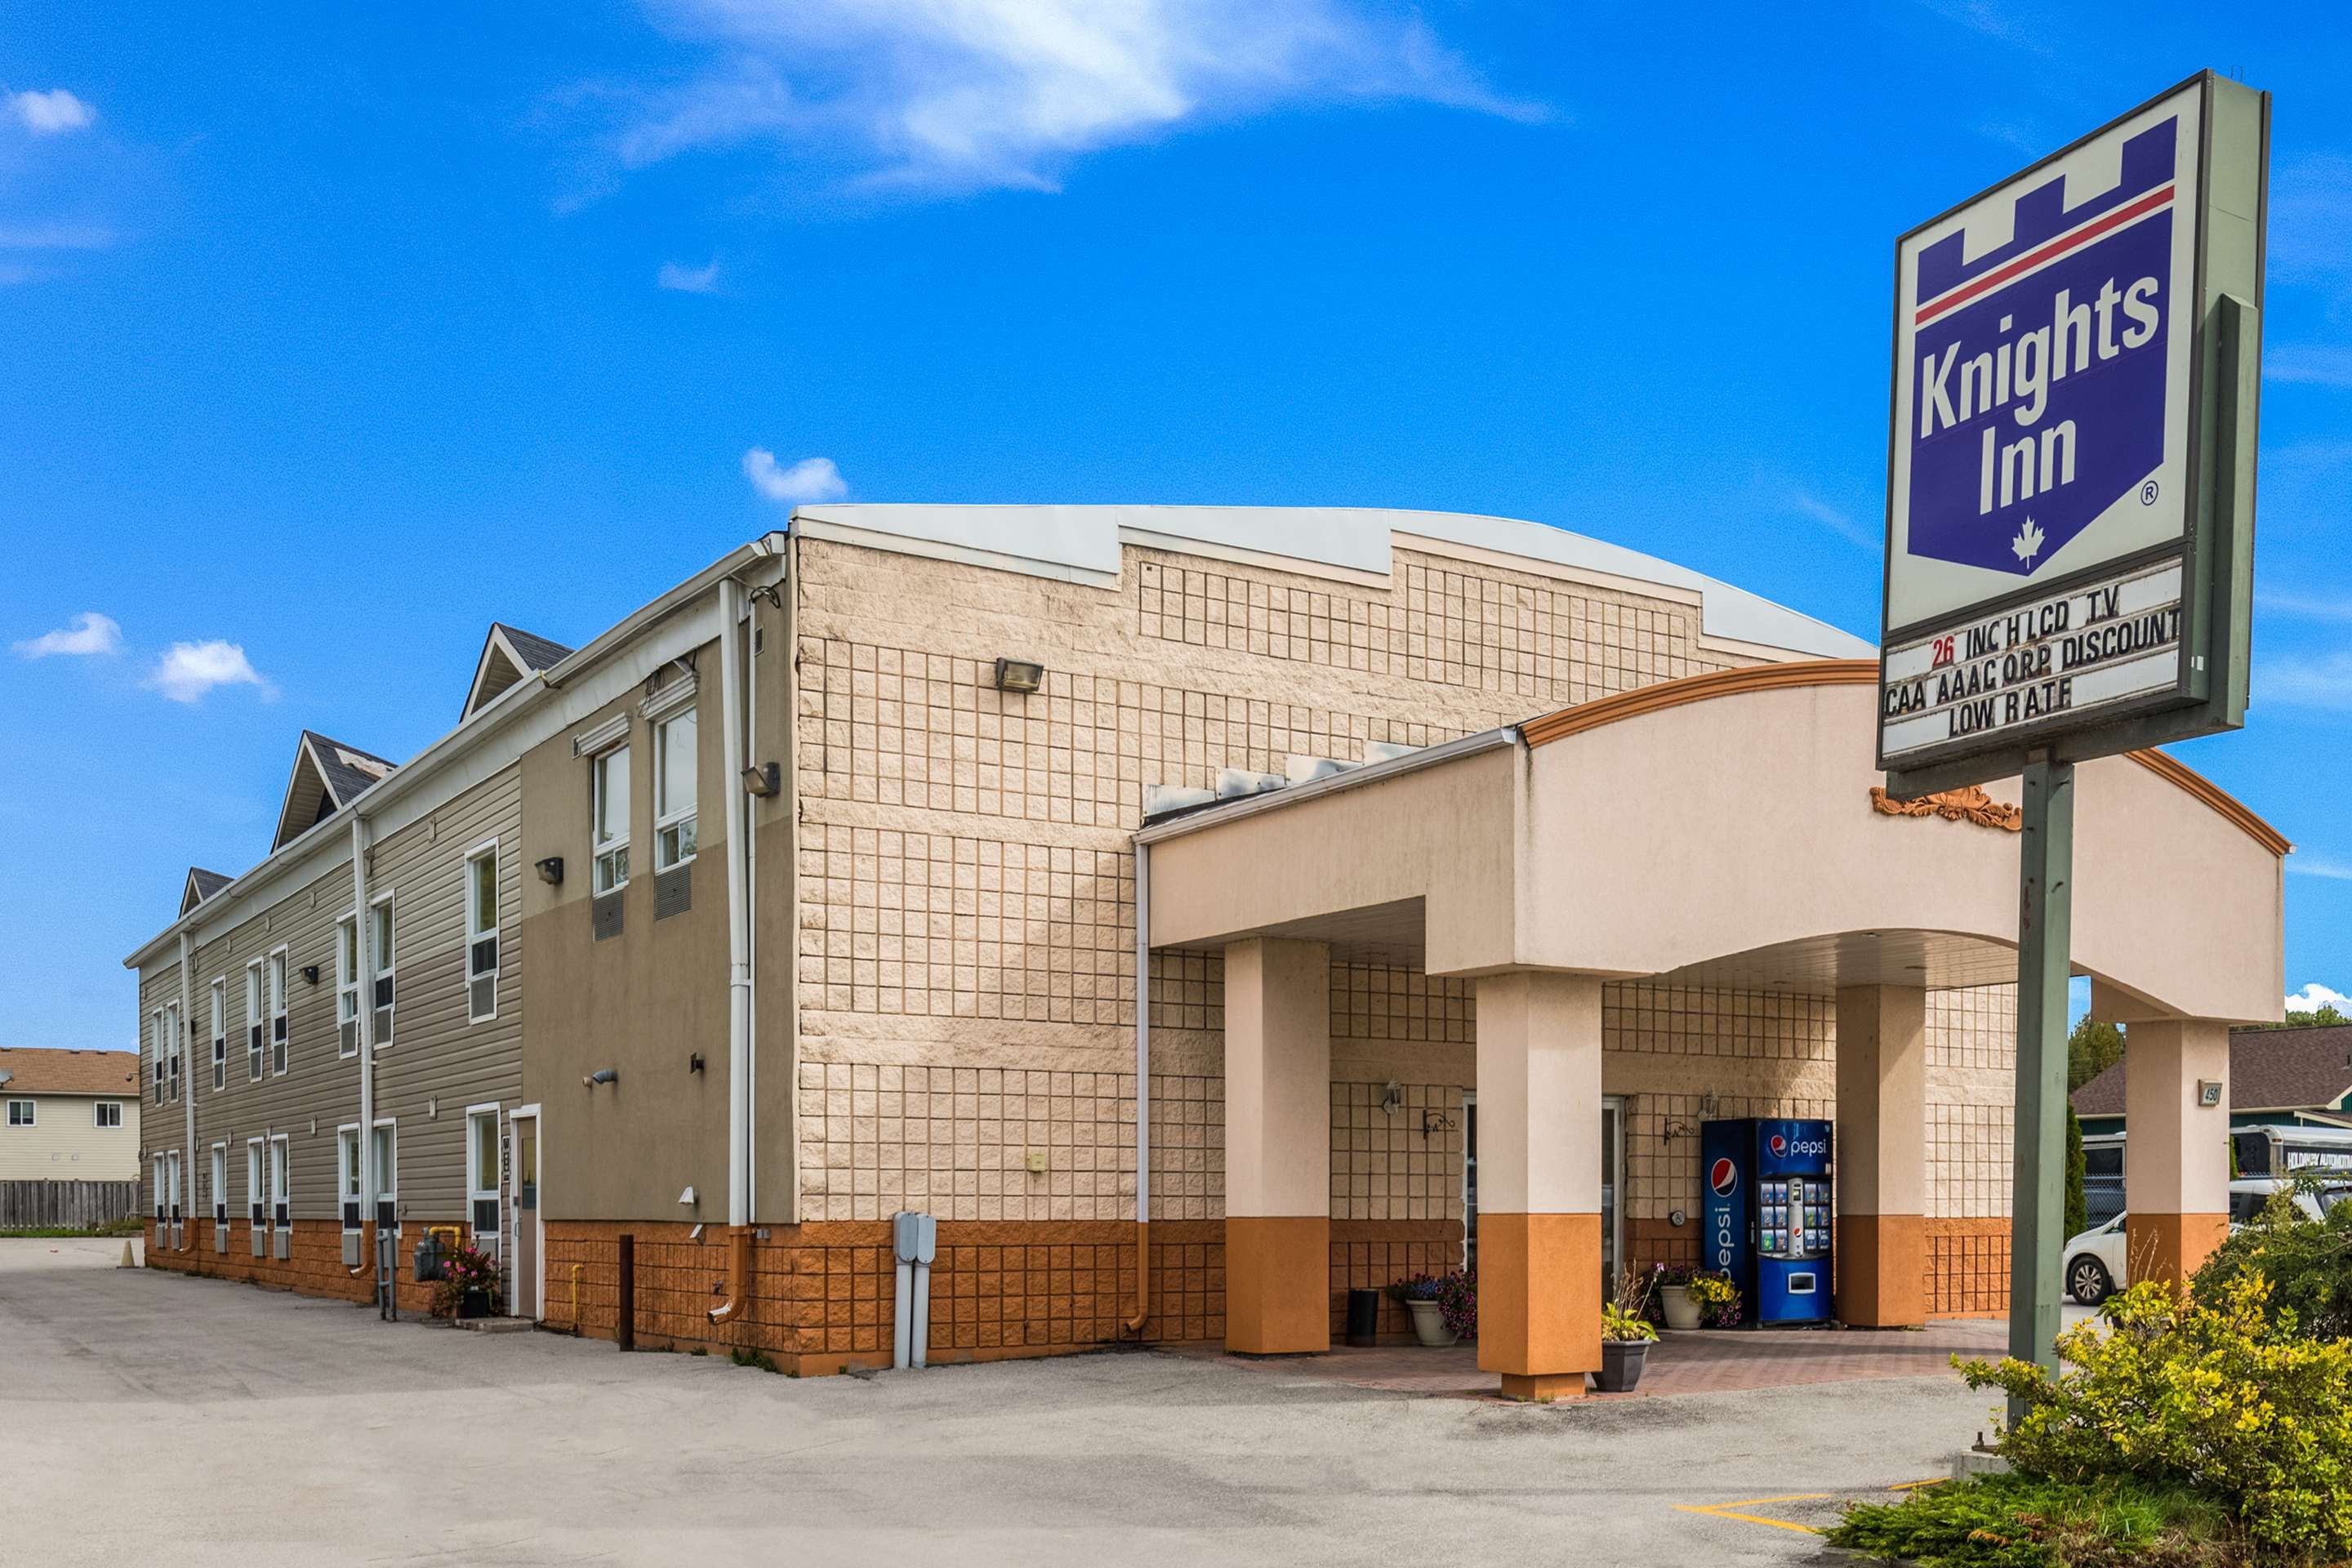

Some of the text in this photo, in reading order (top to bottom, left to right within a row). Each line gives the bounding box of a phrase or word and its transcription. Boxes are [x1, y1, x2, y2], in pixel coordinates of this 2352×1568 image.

[1921, 276, 2159, 439] Knights
[1980, 418, 2077, 515] Inn
[1885, 681, 1927, 717] CAA
[2062, 608, 2180, 670] DISCOUNT
[1933, 635, 1955, 667] 26
[2087, 584, 2119, 622] TV
[1949, 698, 1994, 737] LOW
[2205, 1088, 2219, 1102] 450
[1790, 1138, 1827, 1157] pepsi
